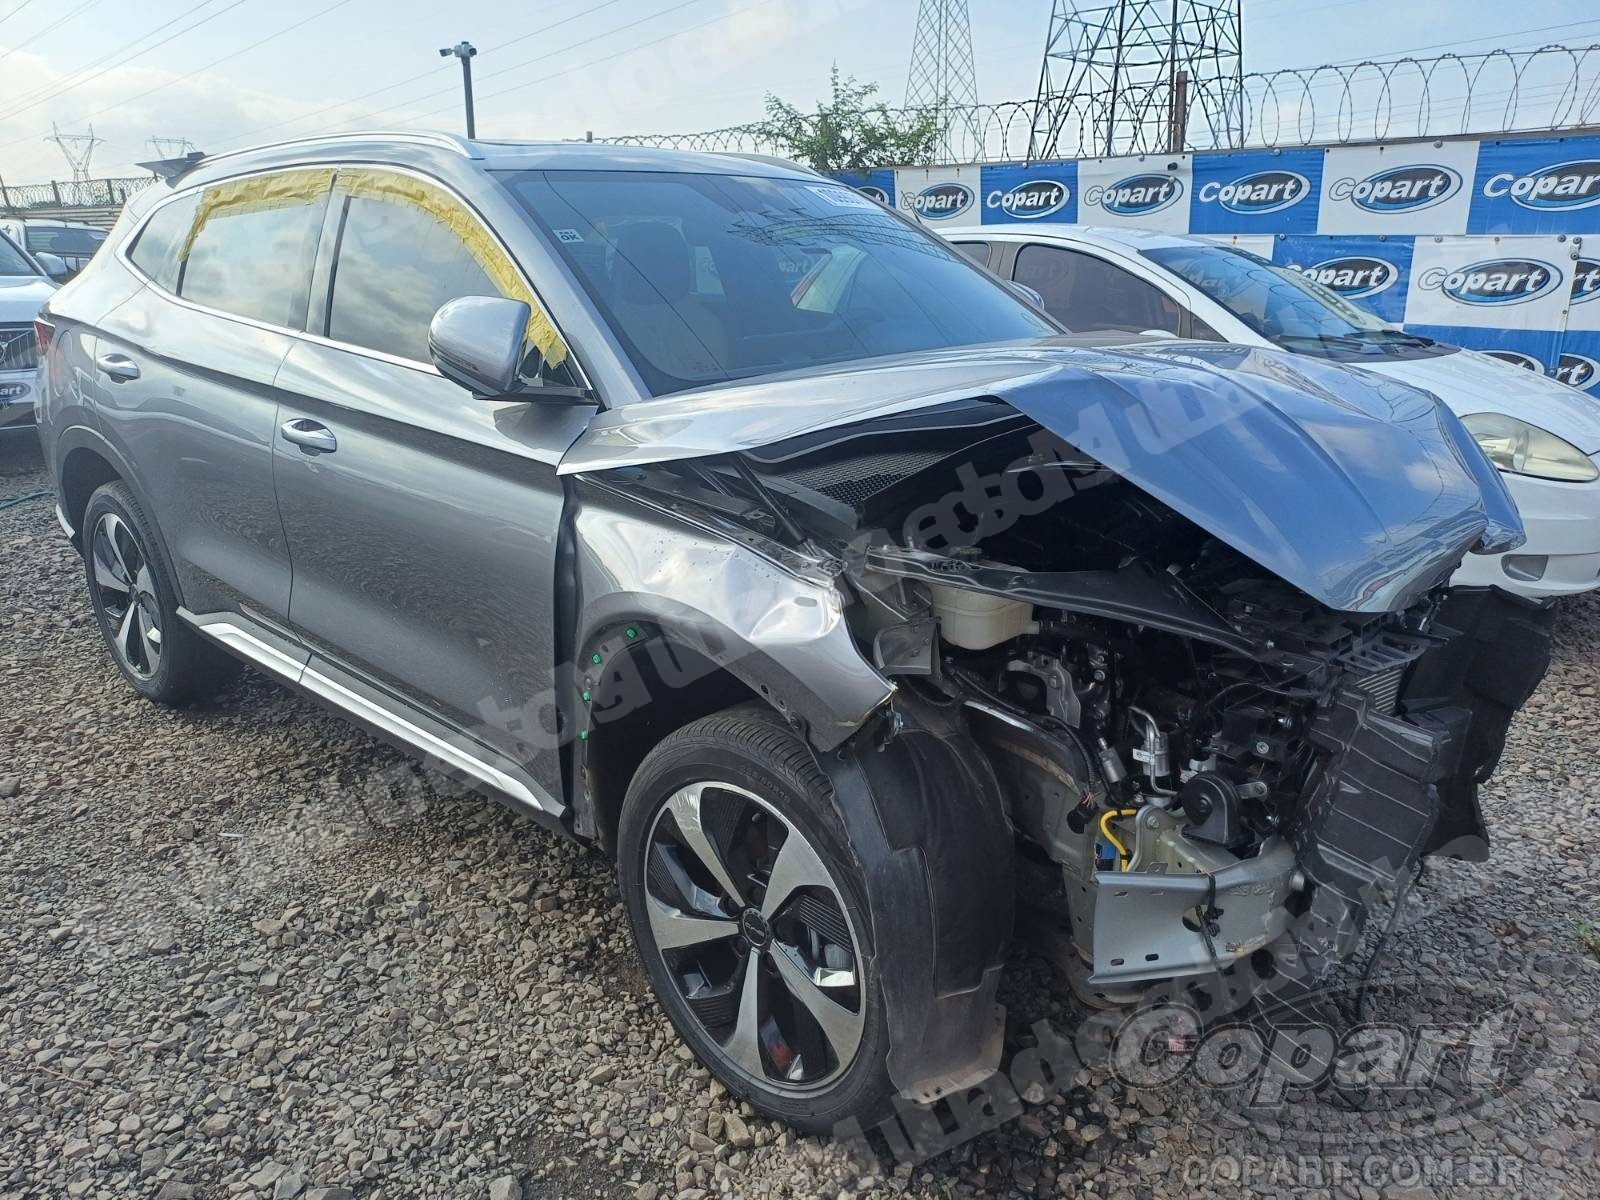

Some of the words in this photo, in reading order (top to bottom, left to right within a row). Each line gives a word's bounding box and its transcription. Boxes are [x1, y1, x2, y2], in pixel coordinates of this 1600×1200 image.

[986, 187, 1060, 215] Copart
[1084, 180, 1170, 210] Copart
[1199, 176, 1298, 205] Copart
[1329, 171, 1446, 206] Copart
[1483, 173, 1600, 201] Copar
[900, 189, 964, 214] Copart
[1418, 265, 1544, 295] Copart
[0, 385, 21, 395] art
